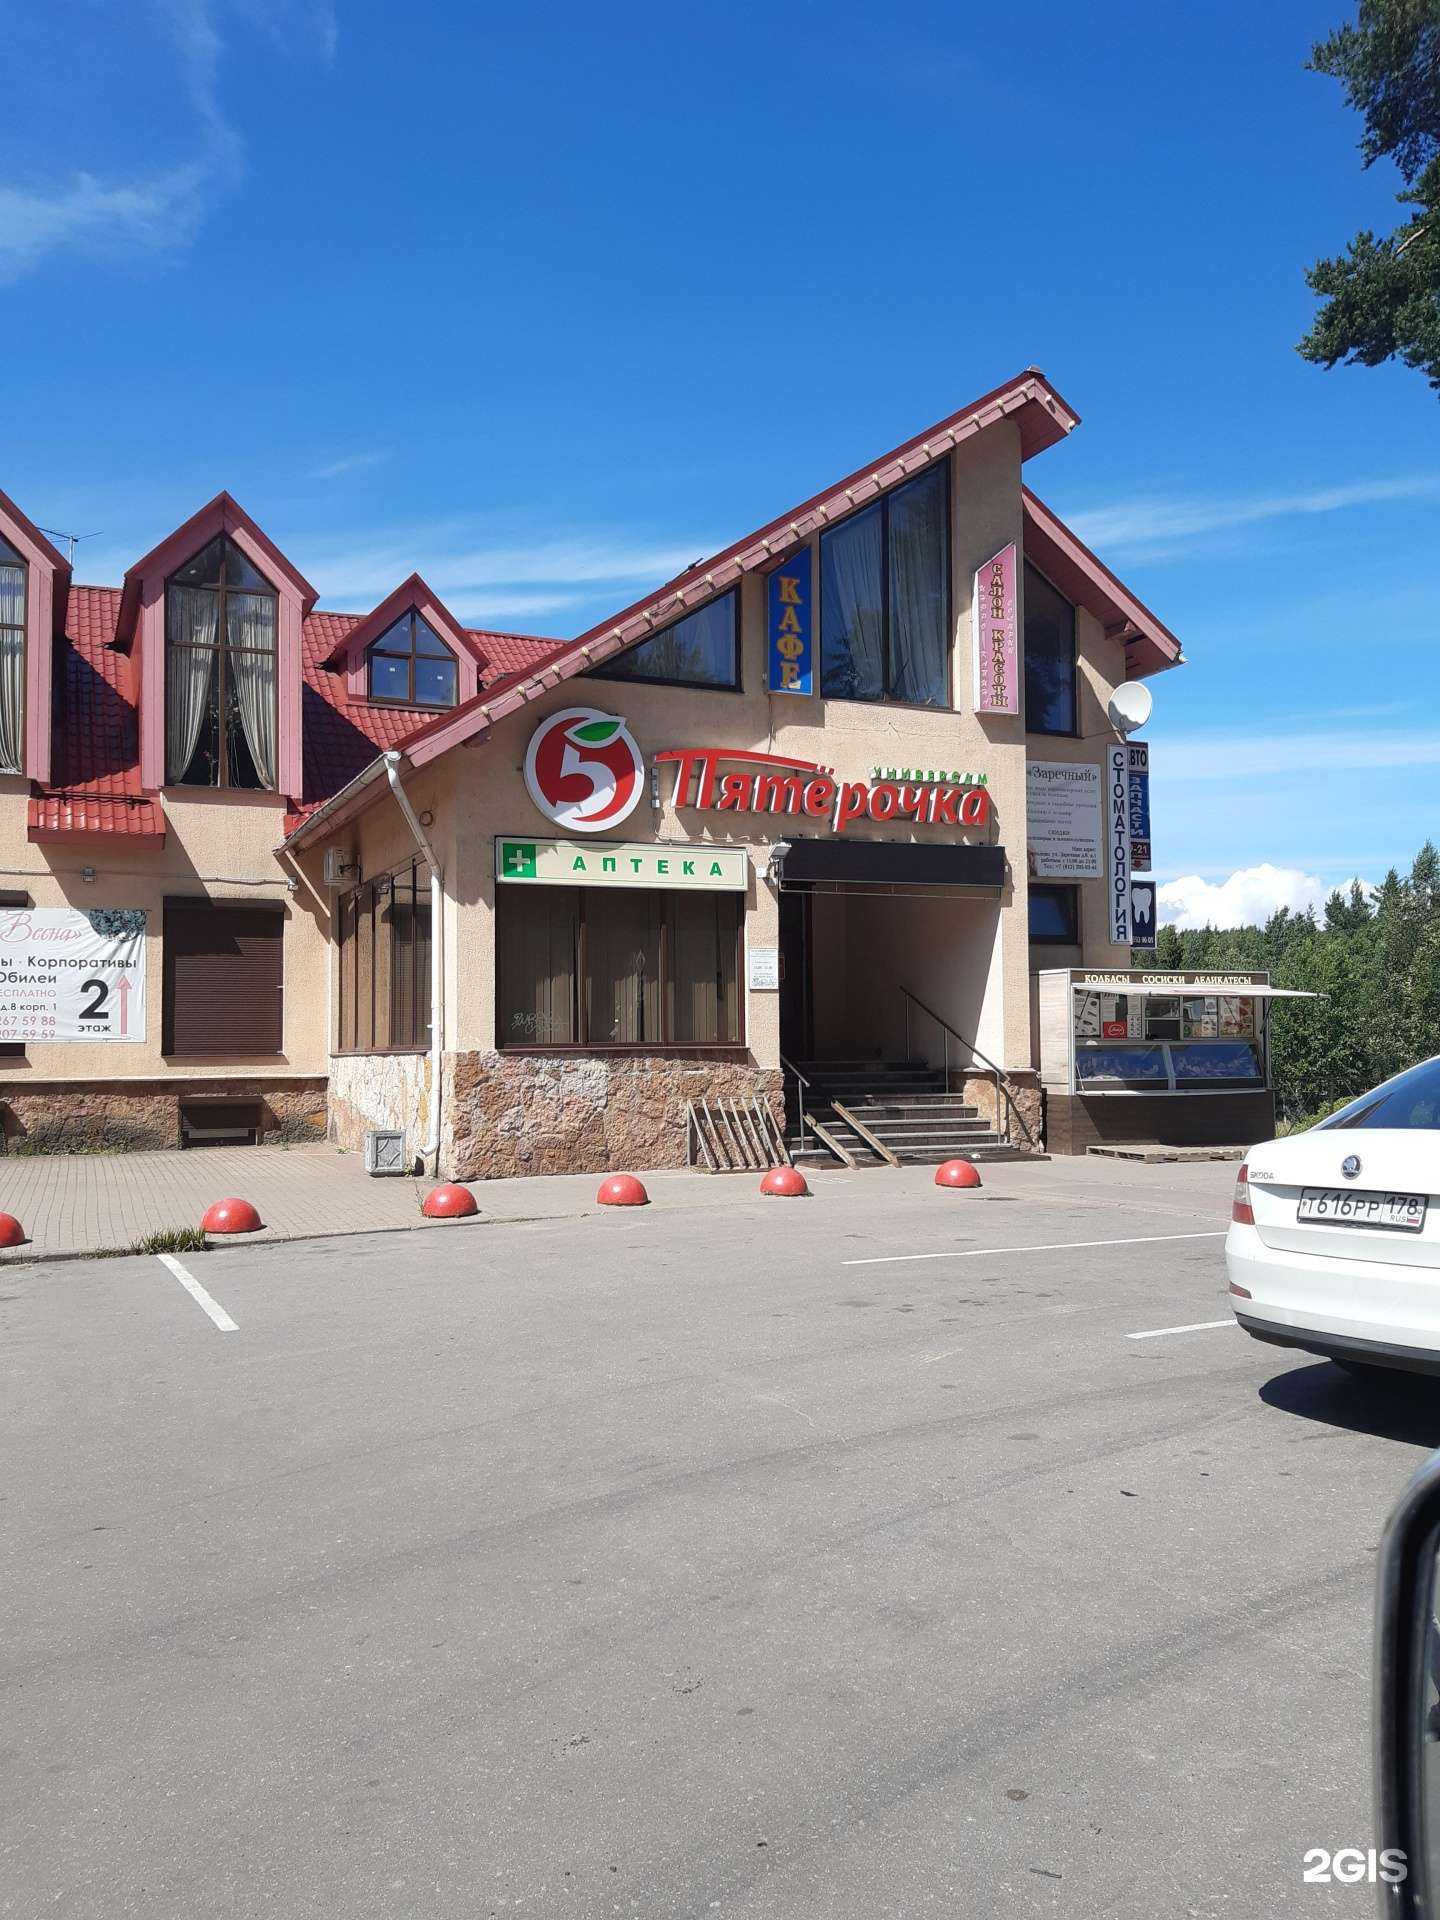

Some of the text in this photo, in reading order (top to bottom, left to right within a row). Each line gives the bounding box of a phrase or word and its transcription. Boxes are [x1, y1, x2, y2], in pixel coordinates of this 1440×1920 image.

[777, 576, 804, 690] КАФЕ
[989, 564, 1008, 707] САЛОН КРАСОТЫ
[1130, 749, 1147, 767] ВТО
[872, 766, 988, 785] УНИВЕРСАМ
[654, 747, 989, 832] Пятёрочка
[1113, 752, 1127, 940] СТОМАТОЛОГИЯ
[572, 853, 723, 877] АПТЕКА
[27, 955, 137, 970] Корпоративы
[1084, 974, 1252, 985] КОЛБАСЫ СОСИСКИ ДЕЛИКАТЕСЫ
[78, 978, 109, 1019] 2
[20, 1004, 49, 1012] корп.
[0, 1016, 56, 1026] 67 59 88
[78, 1024, 112, 1032] этаж
[0, 1029, 56, 1039] 07 59 59
[1386, 1195, 1419, 1216] 178
[1390, 1214, 1409, 1223] RUS
